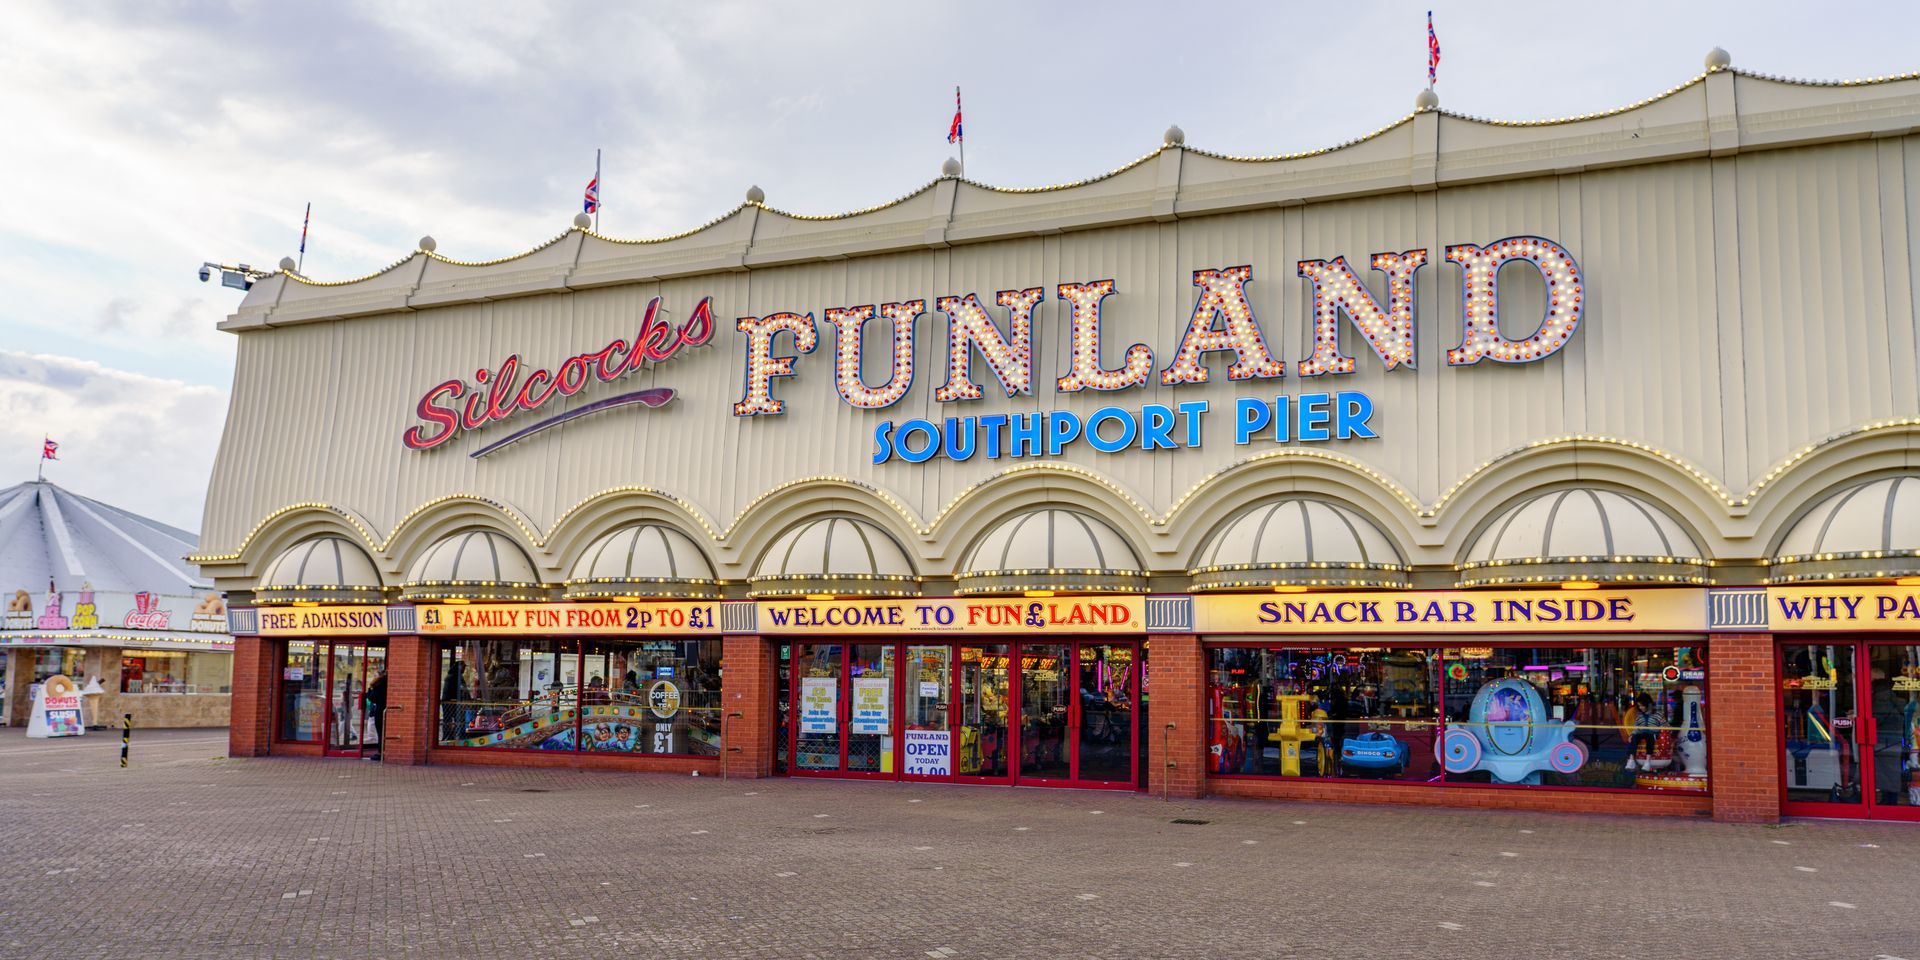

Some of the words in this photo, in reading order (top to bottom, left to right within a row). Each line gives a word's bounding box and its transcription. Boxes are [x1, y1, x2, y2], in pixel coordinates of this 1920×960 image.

[733, 235, 1586, 417] FUNLAND
[403, 296, 716, 450] Silcocks
[873, 400, 1210, 464] SOUTHPORT
[1235, 391, 1380, 445] PIER
[76, 603, 96, 616] POP
[1259, 601, 1383, 623] SNACK
[1395, 601, 1476, 622] BAR
[1493, 598, 1635, 621] INSIDE
[1777, 596, 1863, 619] WHY
[1876, 595, 1920, 619] PA
[71, 615, 99, 629] CORN
[262, 613, 297, 629] FREE
[302, 611, 383, 628] ADMISSION
[425, 609, 441, 625] £1
[453, 610, 520, 627] FAMILY
[525, 610, 560, 627] FUN
[566, 609, 622, 627] FROM
[655, 609, 685, 627] TO
[689, 607, 714, 628] £1
[768, 606, 904, 626] WELCOME
[915, 606, 954, 625] TO
[650, 691, 679, 699] COFFEE
[859, 687, 883, 696] FREE
[45, 696, 78, 704] DONUTS
[658, 702, 672, 710] TEA
[49, 710, 77, 719] SLUSH
[655, 723, 672, 732] ONLY
[653, 732, 673, 754] £1
[906, 743, 949, 756] OPEN
